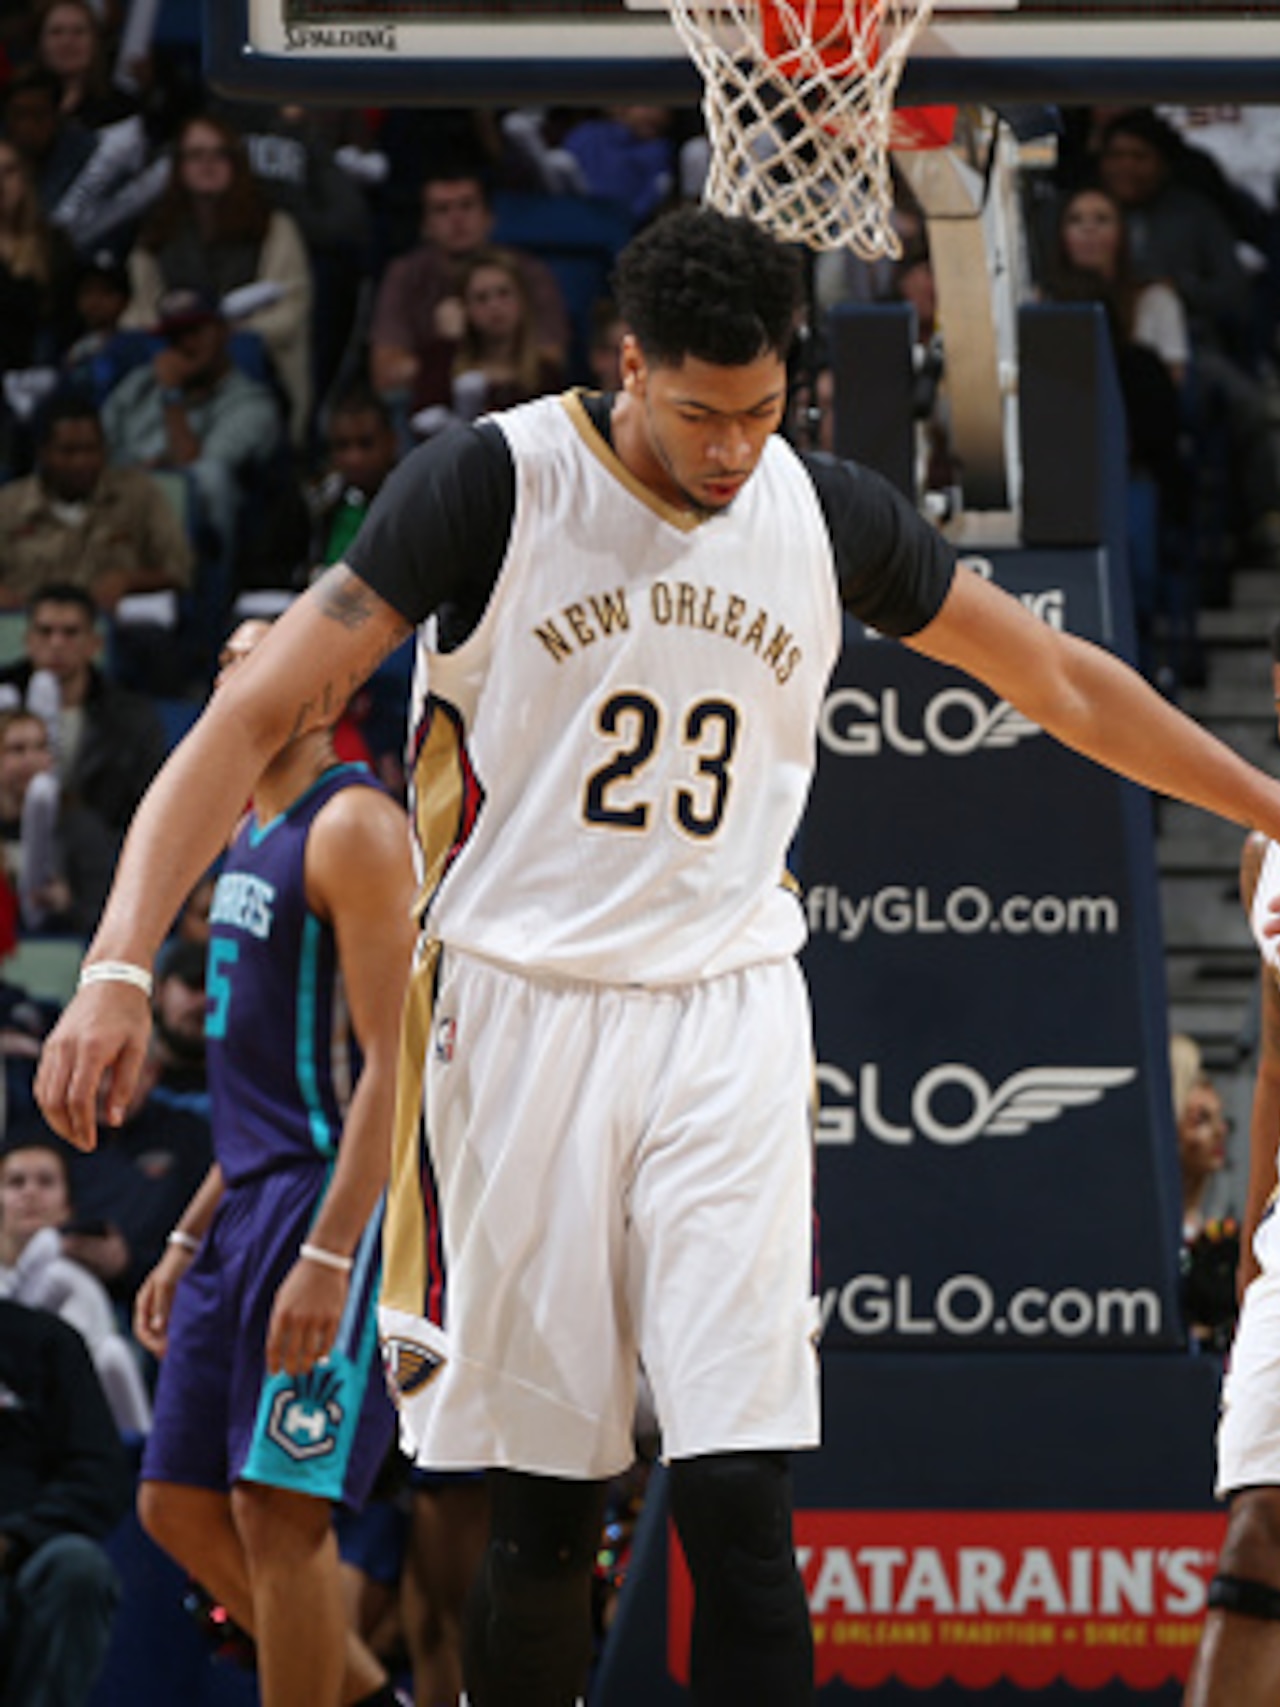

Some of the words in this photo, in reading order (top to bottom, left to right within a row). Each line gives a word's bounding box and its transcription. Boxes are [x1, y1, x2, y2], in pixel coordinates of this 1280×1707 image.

[534, 586, 630, 665] NEW
[651, 581, 802, 685] ORLEANS
[818, 687, 990, 755] GLO
[582, 689, 740, 840] 23
[806, 886, 1119, 942] flyGLO.com
[815, 1062, 990, 1144] GLO
[820, 1274, 1161, 1336] yGLO.com
[796, 1546, 1207, 1615] ATARAIN'S
